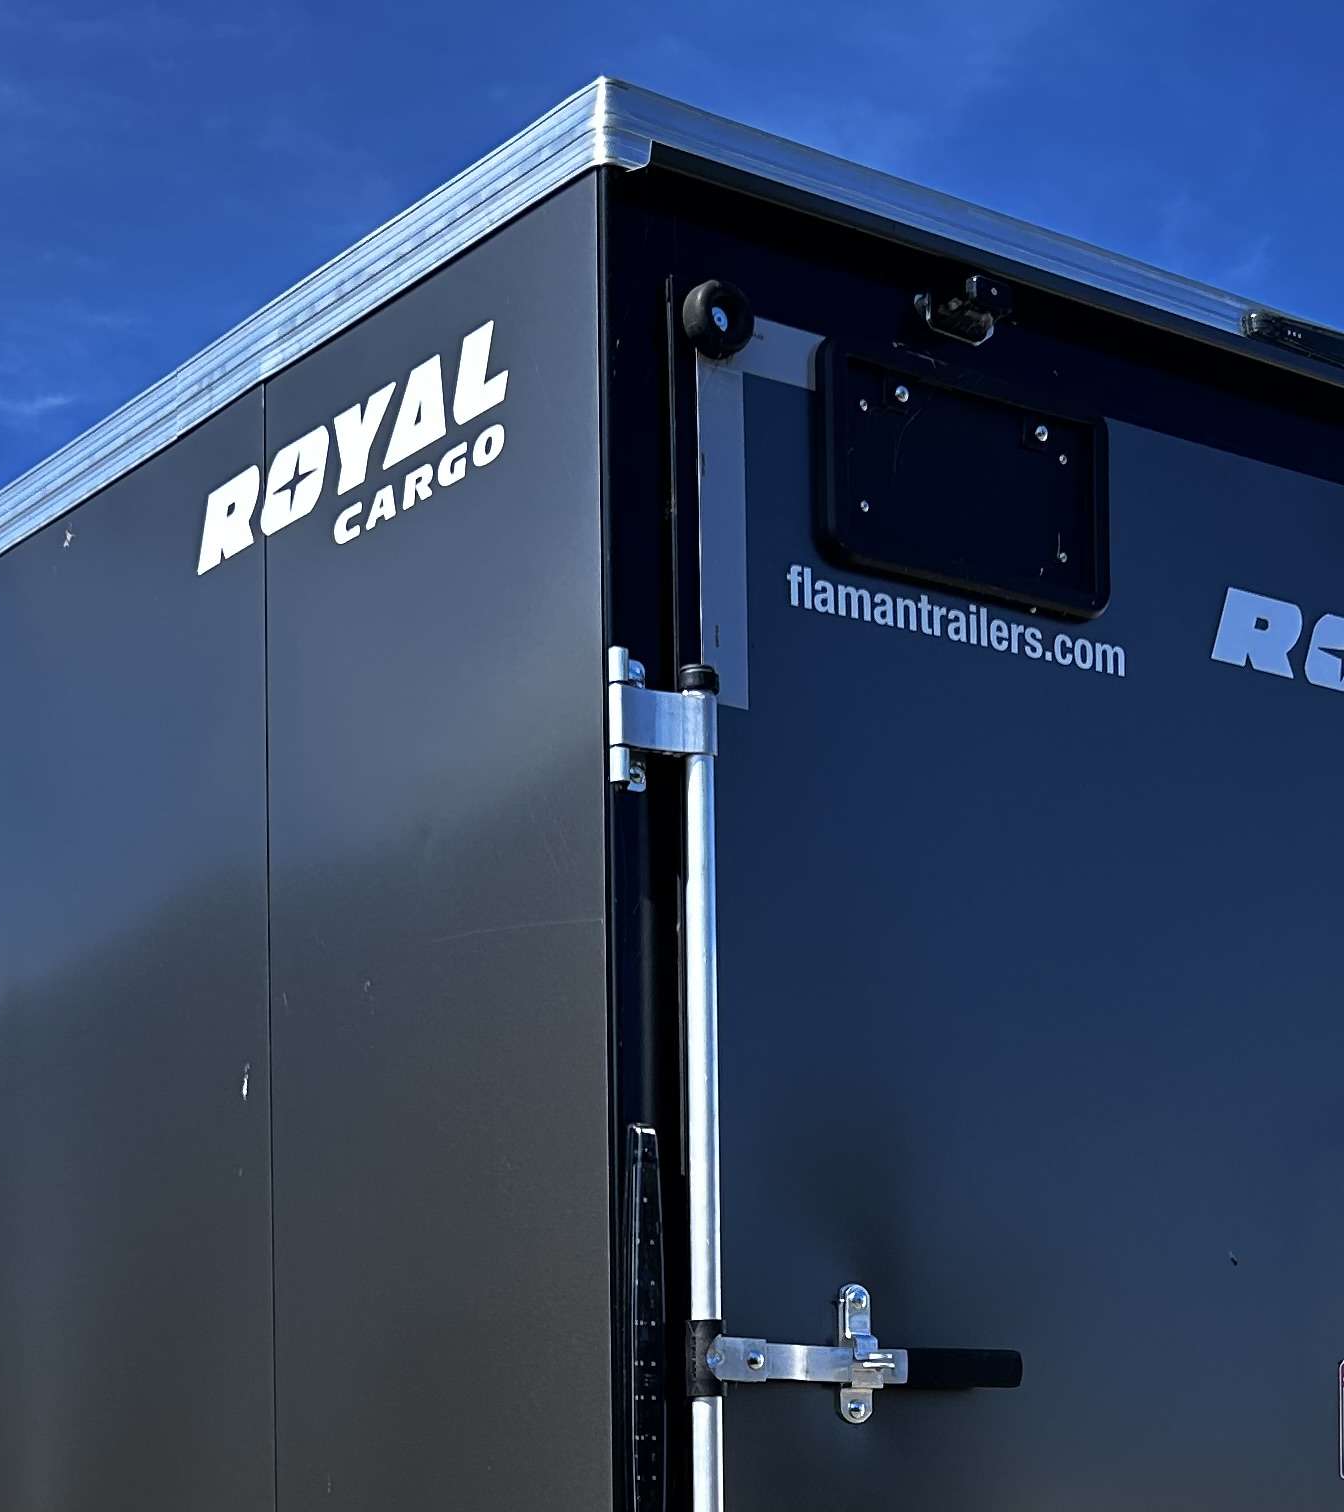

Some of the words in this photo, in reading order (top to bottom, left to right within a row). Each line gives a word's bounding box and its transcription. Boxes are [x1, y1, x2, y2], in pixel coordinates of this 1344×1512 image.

[197, 320, 509, 576] ROYAL
[333, 423, 505, 546] CARGO
[786, 563, 1126, 678] flamantrailers.com
